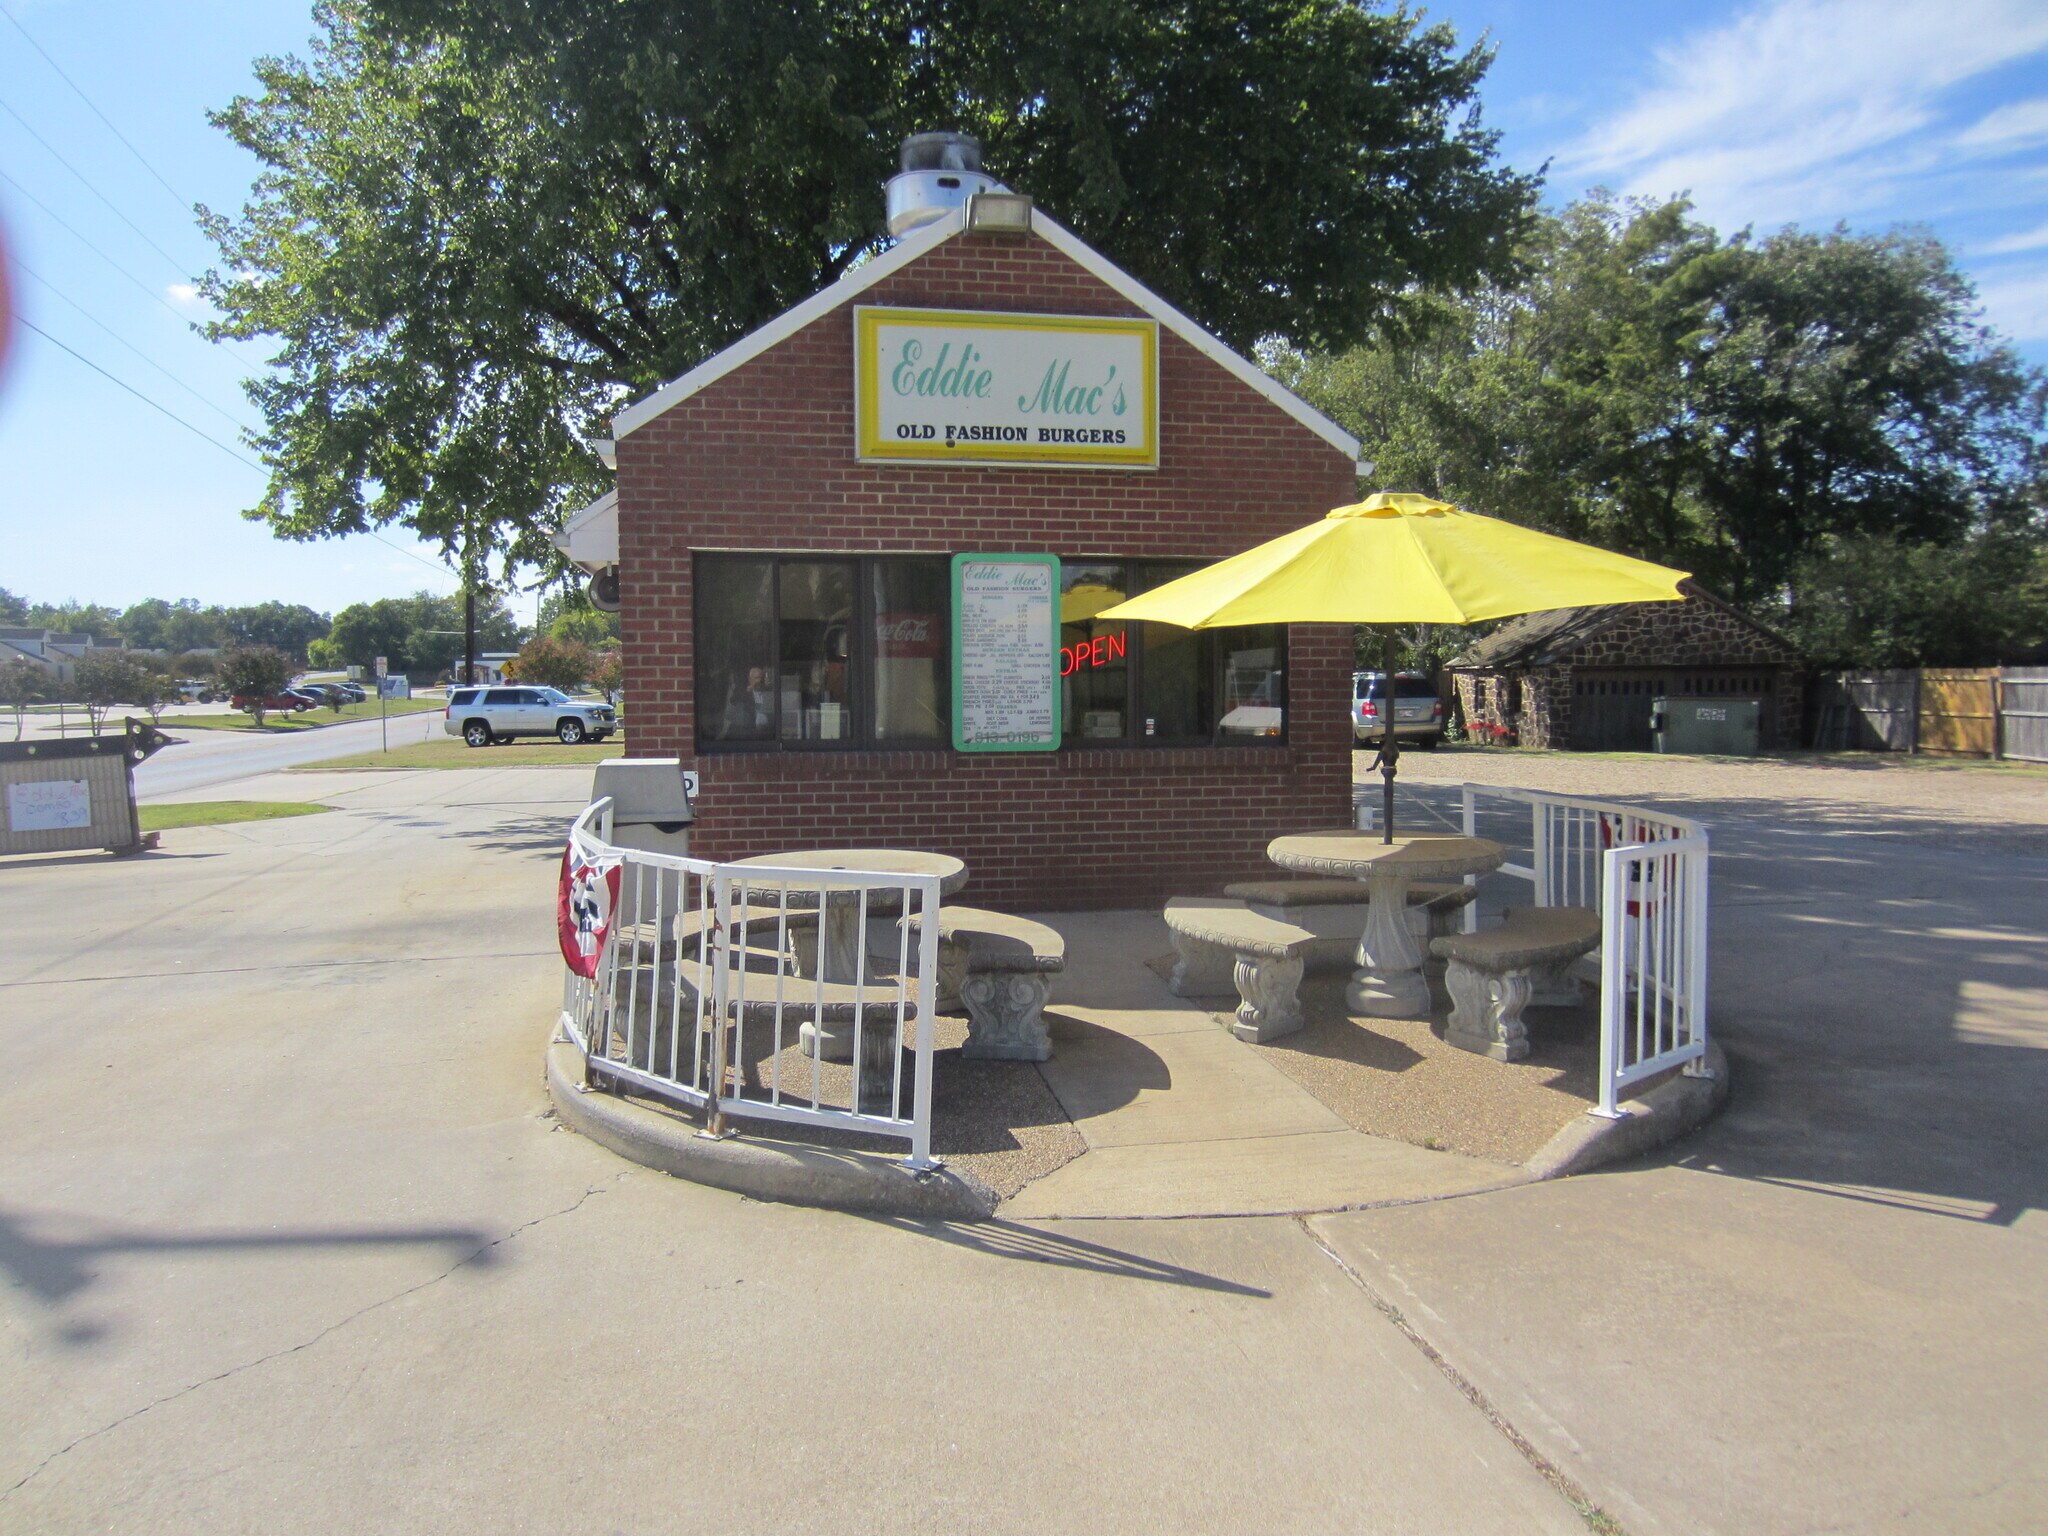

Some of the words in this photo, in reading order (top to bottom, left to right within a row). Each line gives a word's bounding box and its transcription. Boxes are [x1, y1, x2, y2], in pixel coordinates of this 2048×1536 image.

[891, 338, 992, 398] Eddie
[1017, 358, 1128, 416] Mac's
[896, 424, 936, 439] OLD
[945, 425, 1028, 442] FASHION
[1038, 427, 1127, 444] BURGERS
[965, 565, 1003, 580] Eddie
[1005, 571, 1048, 586] Mac's
[1060, 630, 1126, 677] OPEN
